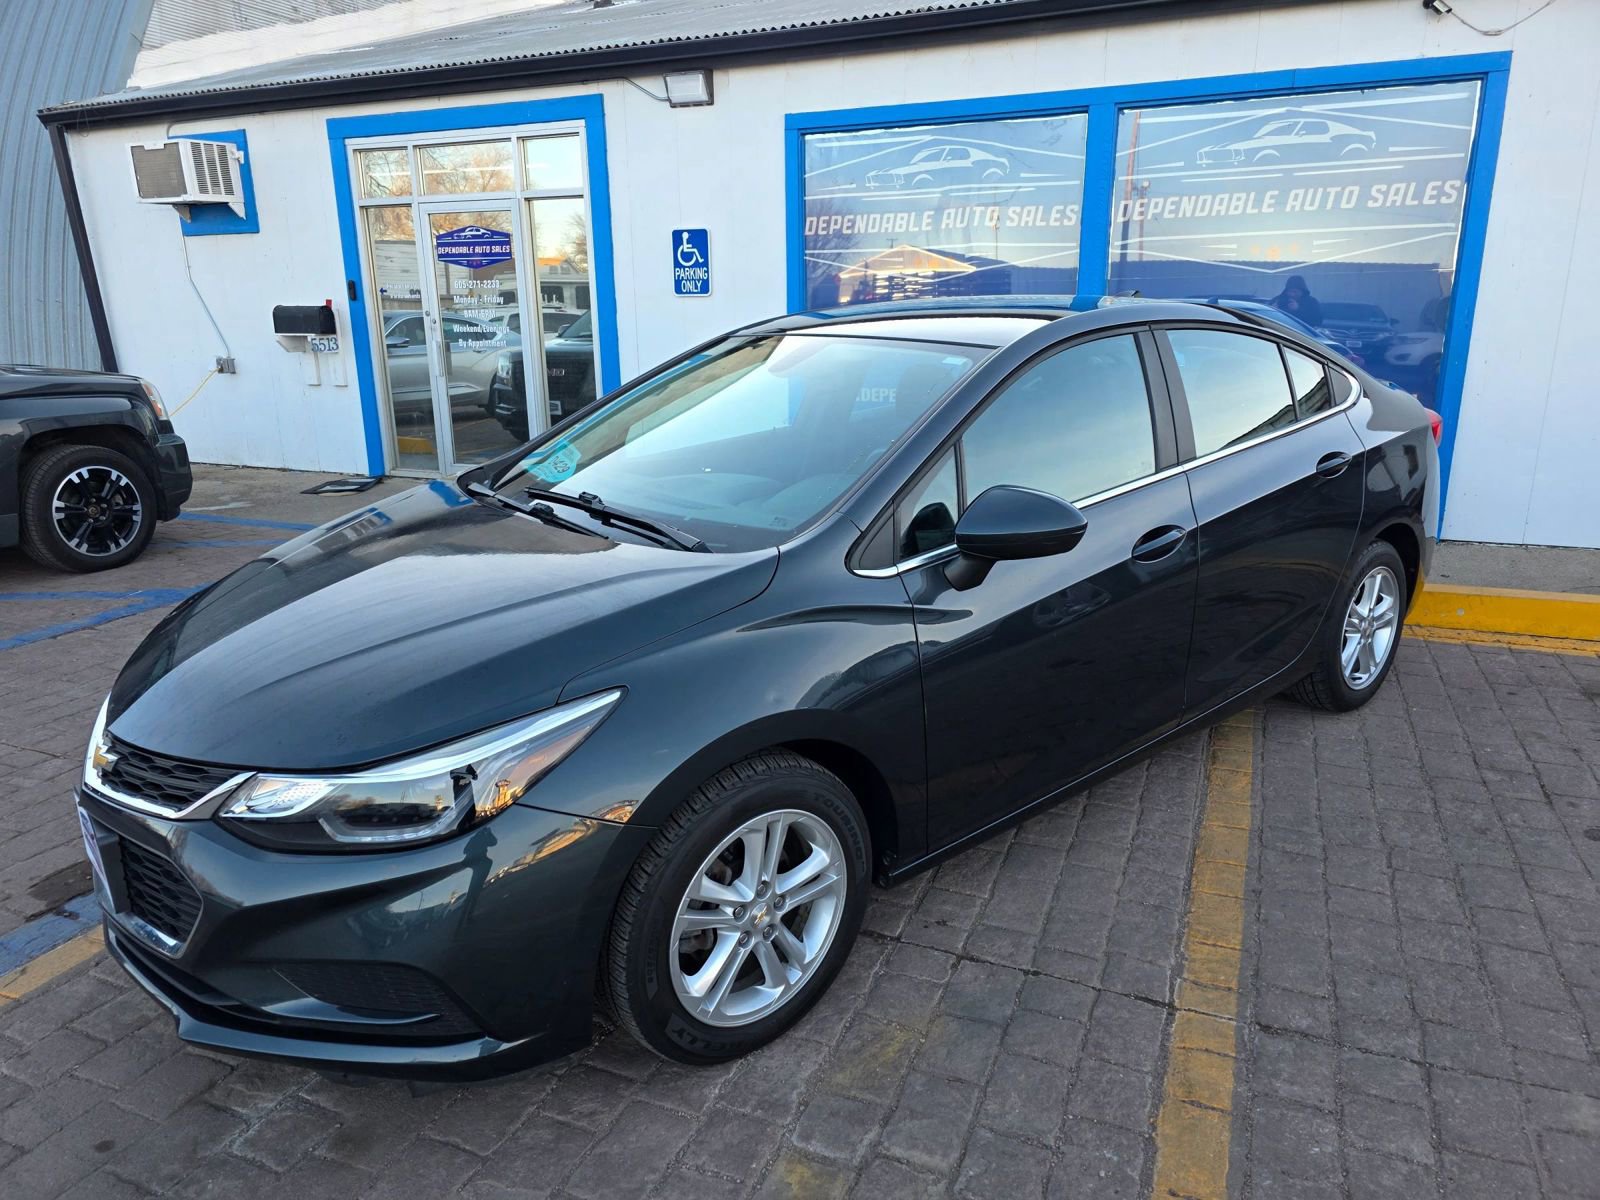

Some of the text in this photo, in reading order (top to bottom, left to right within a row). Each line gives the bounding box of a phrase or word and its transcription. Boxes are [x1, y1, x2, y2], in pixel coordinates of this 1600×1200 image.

[1116, 180, 1462, 223] DEPENDABLE AUTO SALES
[804, 204, 1079, 236] DEPENDABLE AUTO SALES
[437, 245, 511, 255] DEPENDABLE AUTO SALES
[675, 267, 708, 280] PARKING
[681, 280, 703, 293] ONLY
[453, 295, 478, 305] Monday
[484, 294, 504, 305] Friday
[310, 337, 339, 352] 5513
[458, 339, 507, 348] By Appointment
